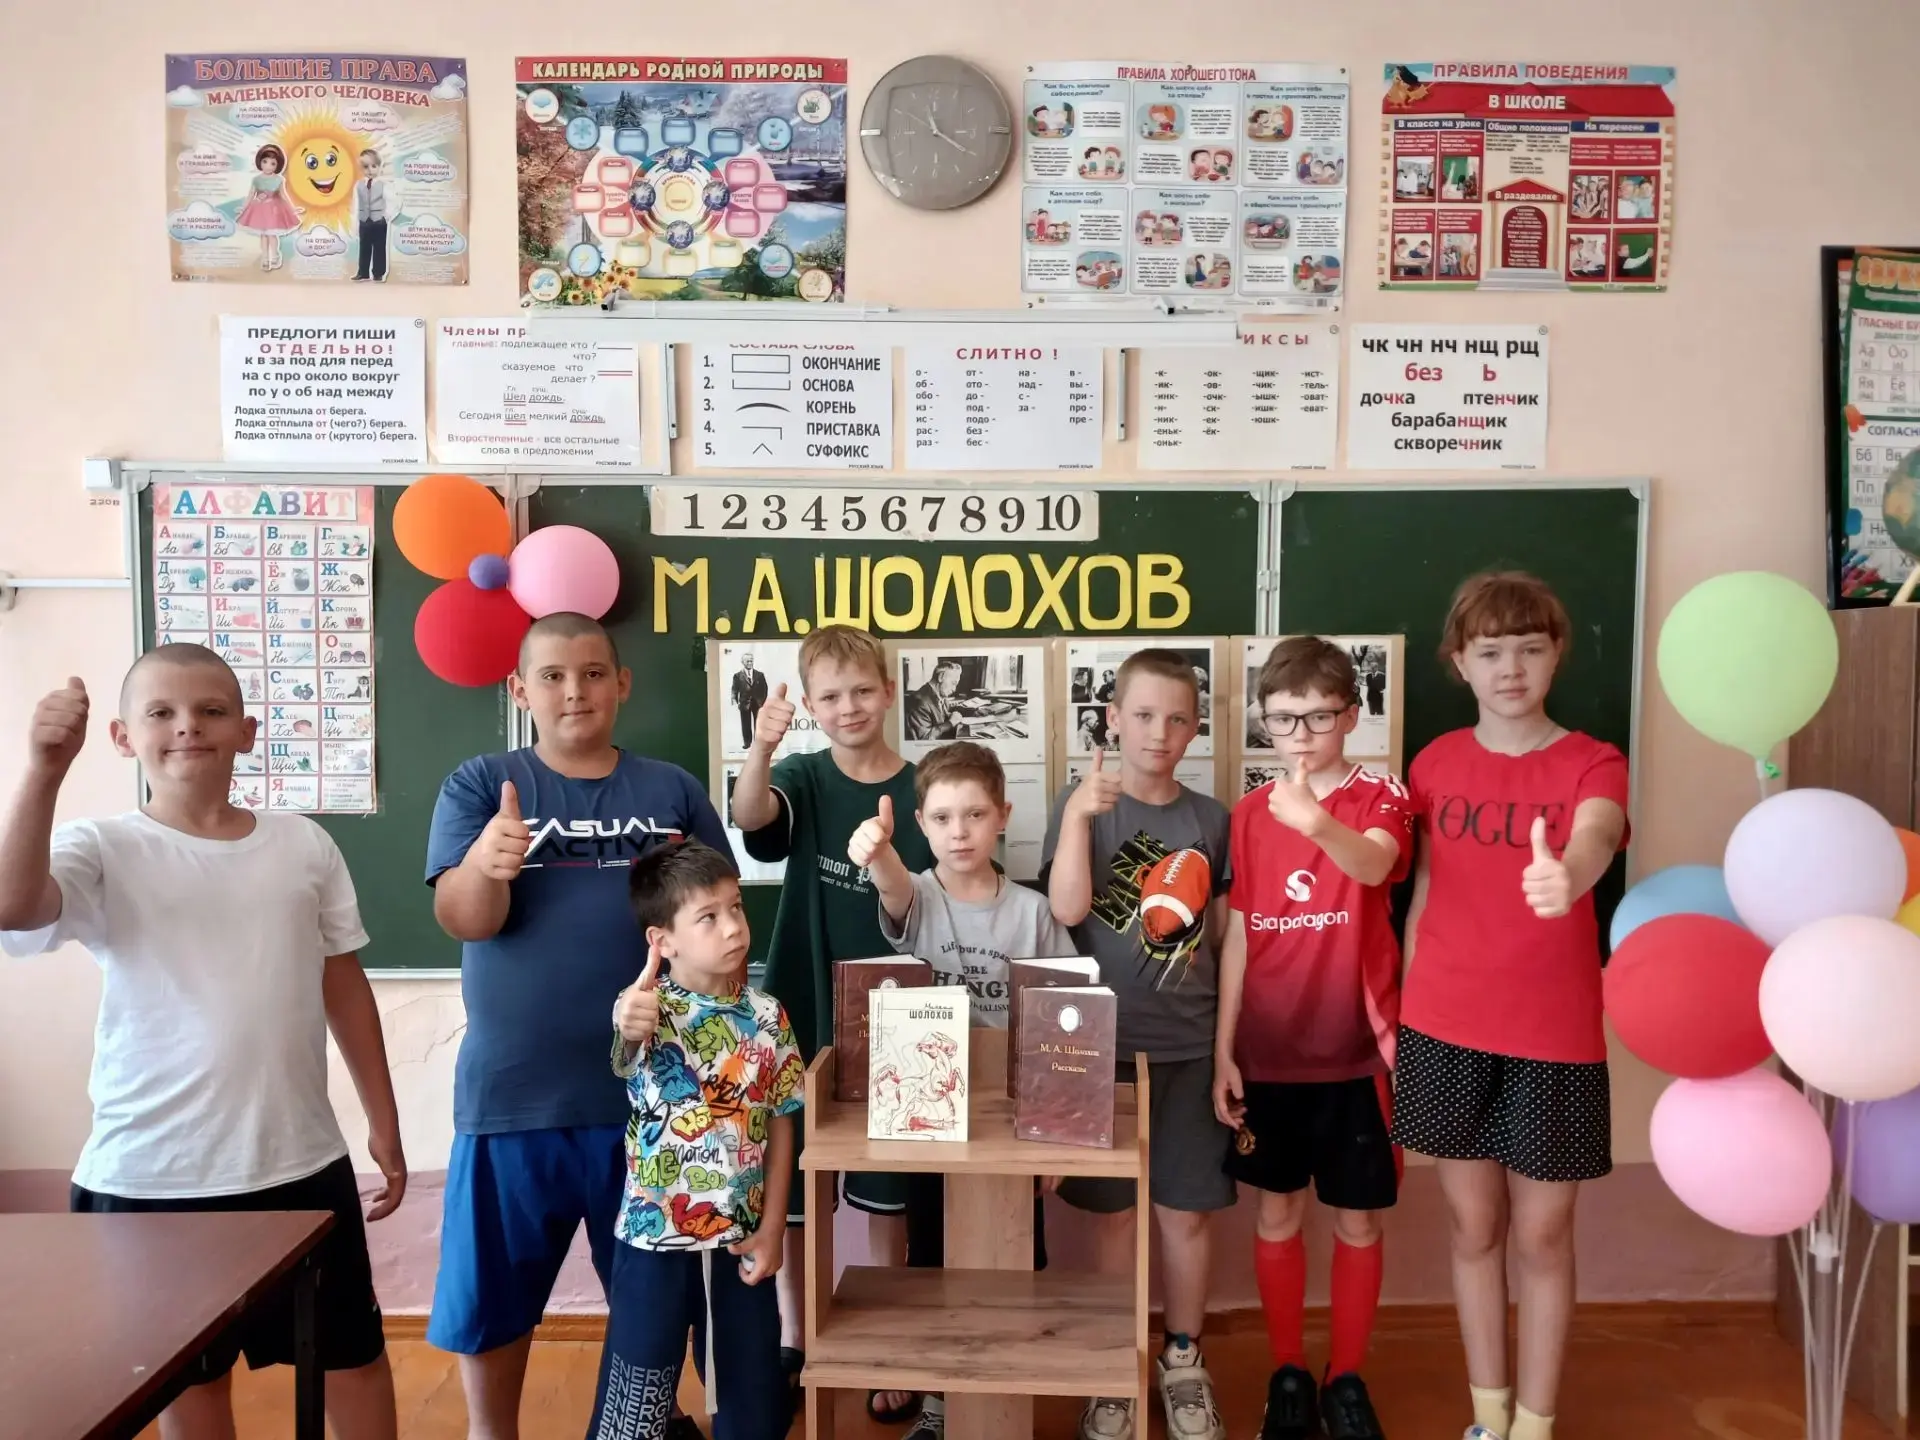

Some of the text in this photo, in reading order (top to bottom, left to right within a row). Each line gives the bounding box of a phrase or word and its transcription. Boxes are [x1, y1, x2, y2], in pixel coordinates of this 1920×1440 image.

[194, 58, 437, 83] БОЛЬШИЕ ПРАВА
[532, 60, 824, 81] КАЛЕНДАРЬ РОДНОЙ ПРИРОДЫ
[1117, 67, 1256, 81] ПРАВИЛА ХОРОШЕГО ТОНА
[1433, 64, 1628, 80] ПРАВИЛА ПОВЕДЕНИЯ
[207, 84, 431, 107] МАЛЕНЬКОГО ЧЕЛОВЕКА
[1488, 95, 1566, 110] В ШКОЛЕ
[1398, 119, 1482, 130] В классе на уроке
[1488, 122, 1569, 133] Общие положения
[1585, 122, 1645, 132] На перемене
[1495, 191, 1558, 201] В раздевалке
[1858, 316, 1904, 330] ГЛАСНЫЕ
[248, 328, 396, 341] ПРЕДЛОГИ ПИШИ
[443, 325, 500, 336] Члены
[452, 340, 588, 350] главные: подлежащее кто
[1243, 334, 1309, 345] ИКСЫ
[957, 348, 1042, 360] СЛИТНО
[1362, 339, 1540, 358] чк чн нч нщ рщ
[245, 357, 393, 368] к в за под для перед
[573, 352, 597, 361] что?
[502, 363, 584, 373] сказуемое что
[703, 355, 881, 371] 1. ОКОНЧАНИЕ
[242, 372, 400, 384] на с про около вокруг
[1405, 363, 1443, 381] без
[550, 375, 588, 384] делает
[703, 376, 855, 392] 2. ОСНОВА
[249, 386, 394, 399] по у о об над между
[503, 392, 526, 401] Шел
[703, 398, 856, 414] 3. КОРЕНЬ
[1360, 393, 1539, 407] дочка птенчик
[234, 406, 266, 416] Лодка
[269, 407, 313, 415] отплыла
[329, 406, 367, 417] берега.
[459, 411, 502, 421] Сегодня
[529, 411, 568, 421] мелкий
[234, 418, 407, 430] Лодка отплыла от (чего?) берега.
[1392, 412, 1508, 430] барабанщик
[703, 420, 881, 436] 4. ПРИСТАВКА
[234, 430, 417, 442] Лодка отплыла от (крутого) берега.
[447, 434, 620, 445] Второстепенные все остальные
[705, 442, 869, 458] 5. СУФФИКС
[1394, 438, 1503, 453] скворечник
[481, 447, 510, 455] слова
[522, 447, 594, 457] предложении
[1855, 448, 1873, 462] Бб
[174, 490, 352, 516] АЛФАВИТ
[684, 493, 1081, 533] 1 2 3 4 5 6 7 8 9 10
[909, 1010, 954, 1020] ШОЛОХОВ
[1040, 1043, 1051, 1053] М.
[1053, 1045, 1063, 1053] А.
